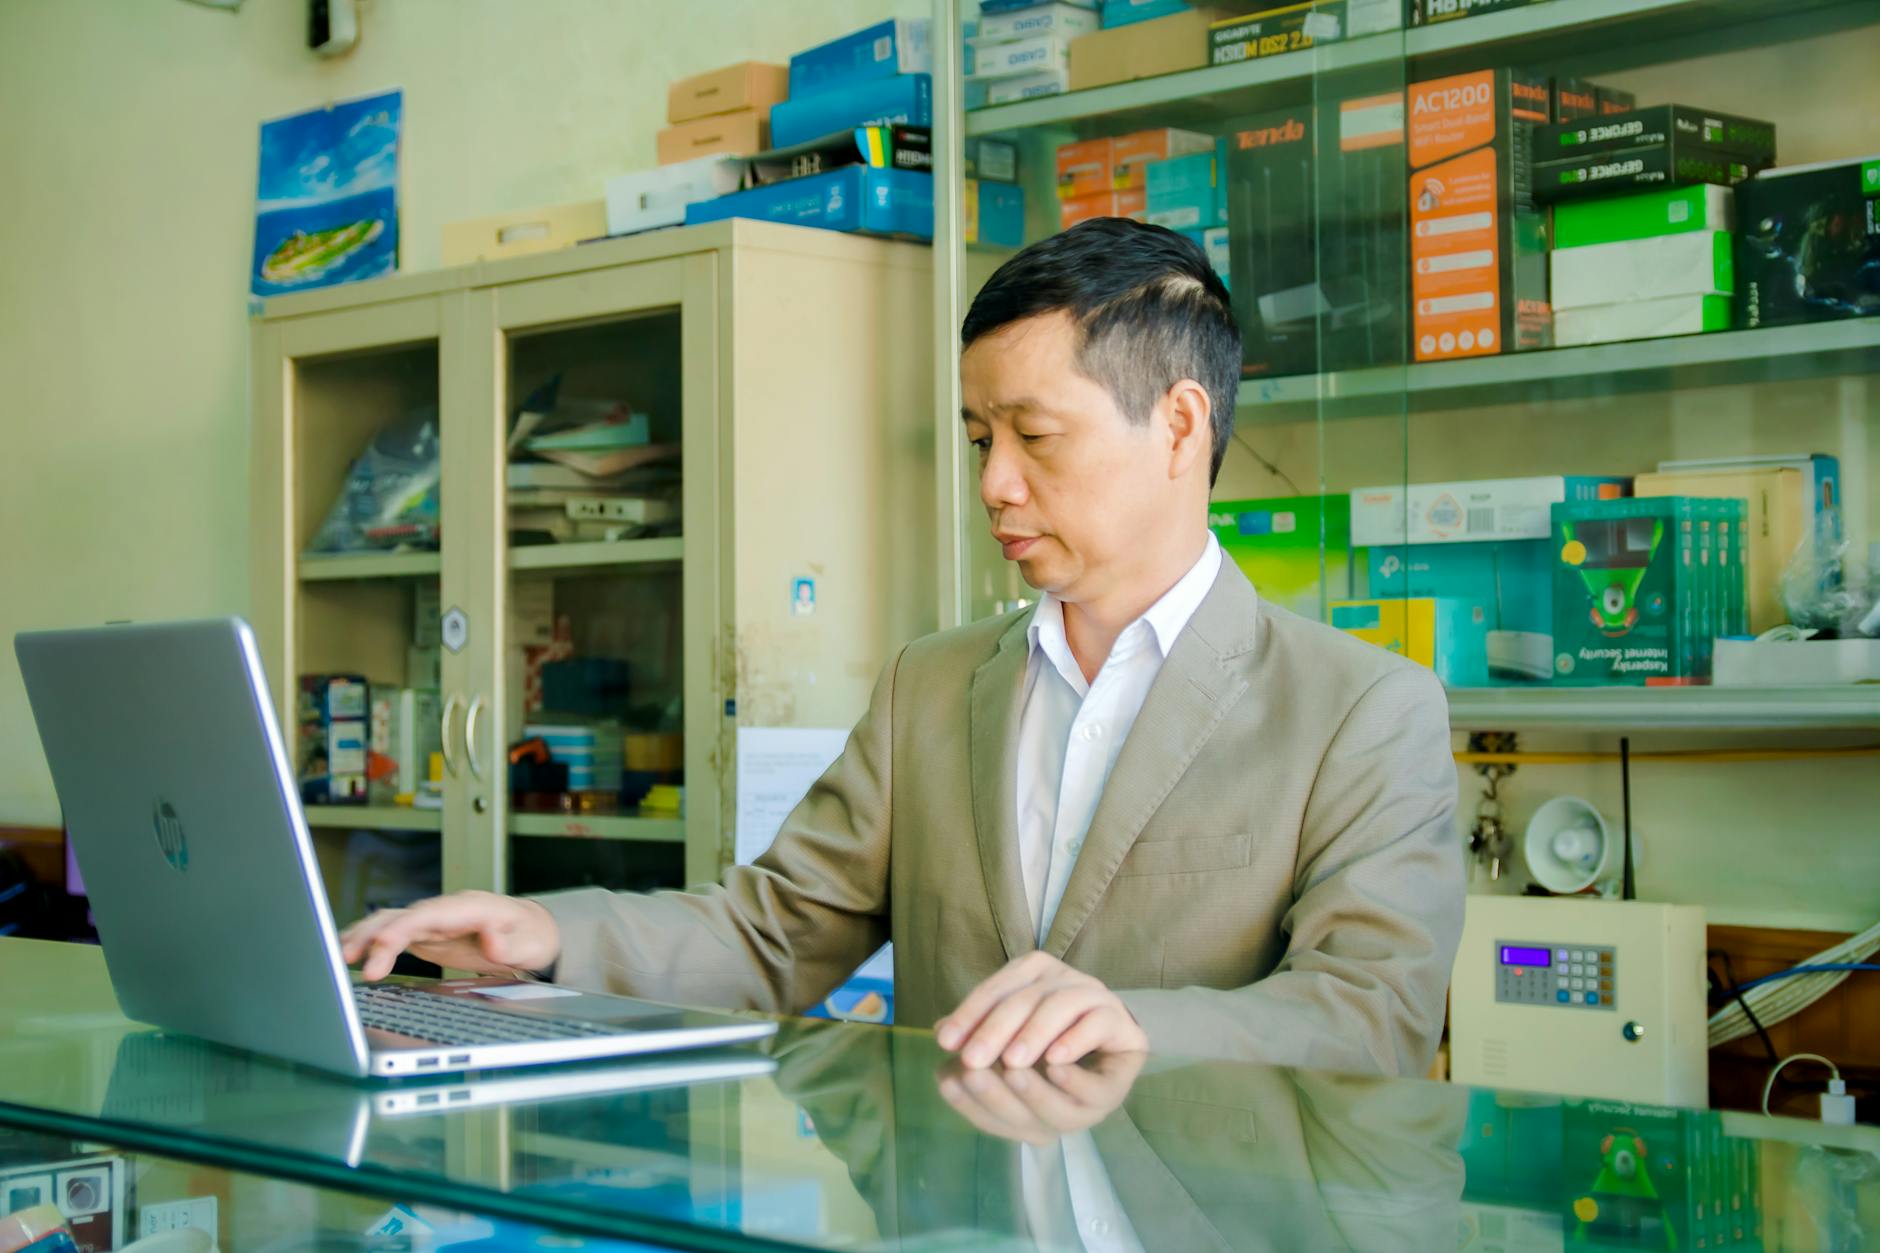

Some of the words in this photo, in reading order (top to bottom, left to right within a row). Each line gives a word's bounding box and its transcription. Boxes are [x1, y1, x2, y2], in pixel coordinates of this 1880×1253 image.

[1414, 83, 1490, 114] AC1200
[1589, 120, 1643, 142] GEFORCE
[1588, 159, 1643, 181] GEFORCE
[1578, 647, 1623, 660] Security
[1624, 648, 1668, 659] Internet
[1611, 656, 1668, 673] Kaspersky
